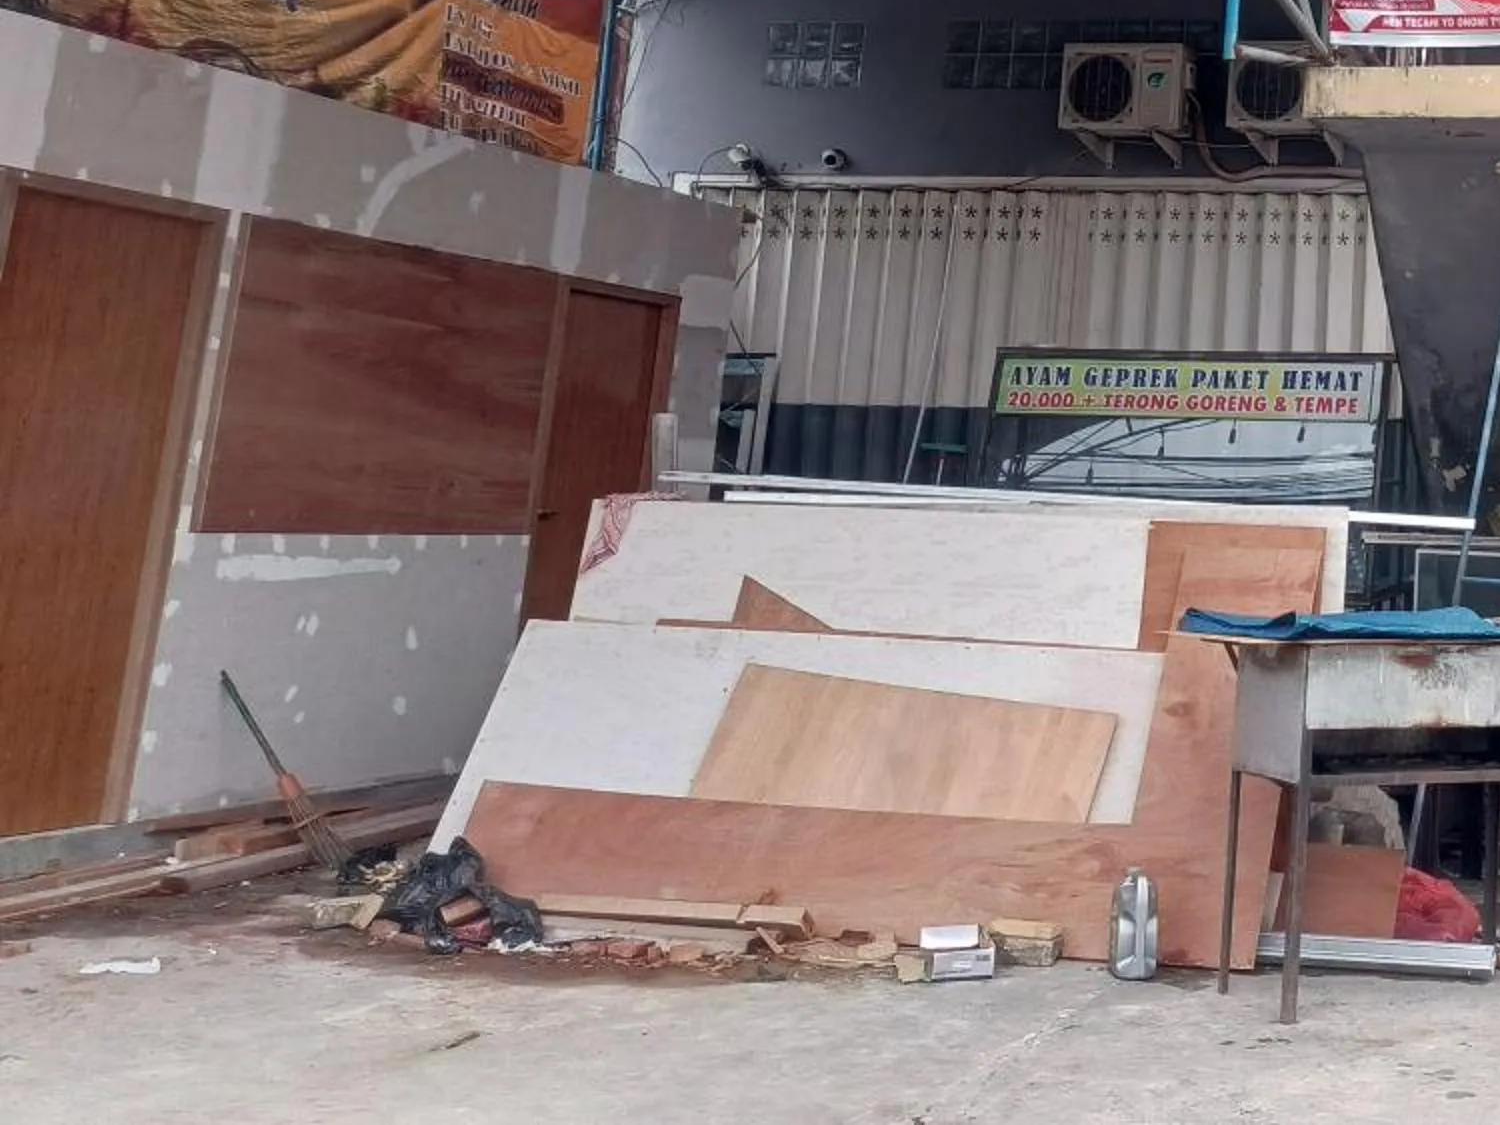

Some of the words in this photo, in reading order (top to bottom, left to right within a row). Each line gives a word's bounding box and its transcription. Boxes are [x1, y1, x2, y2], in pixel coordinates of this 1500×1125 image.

[1010, 366, 1071, 386] AYAM
[1084, 367, 1178, 389] GEPREK
[1190, 370, 1270, 391] PAKET
[1281, 371, 1363, 392] HEMAT
[1104, 393, 1178, 411] TERONG
[1185, 394, 1267, 413] GORENG
[1274, 395, 1286, 413] &
[1294, 396, 1359, 414] TEMPE
